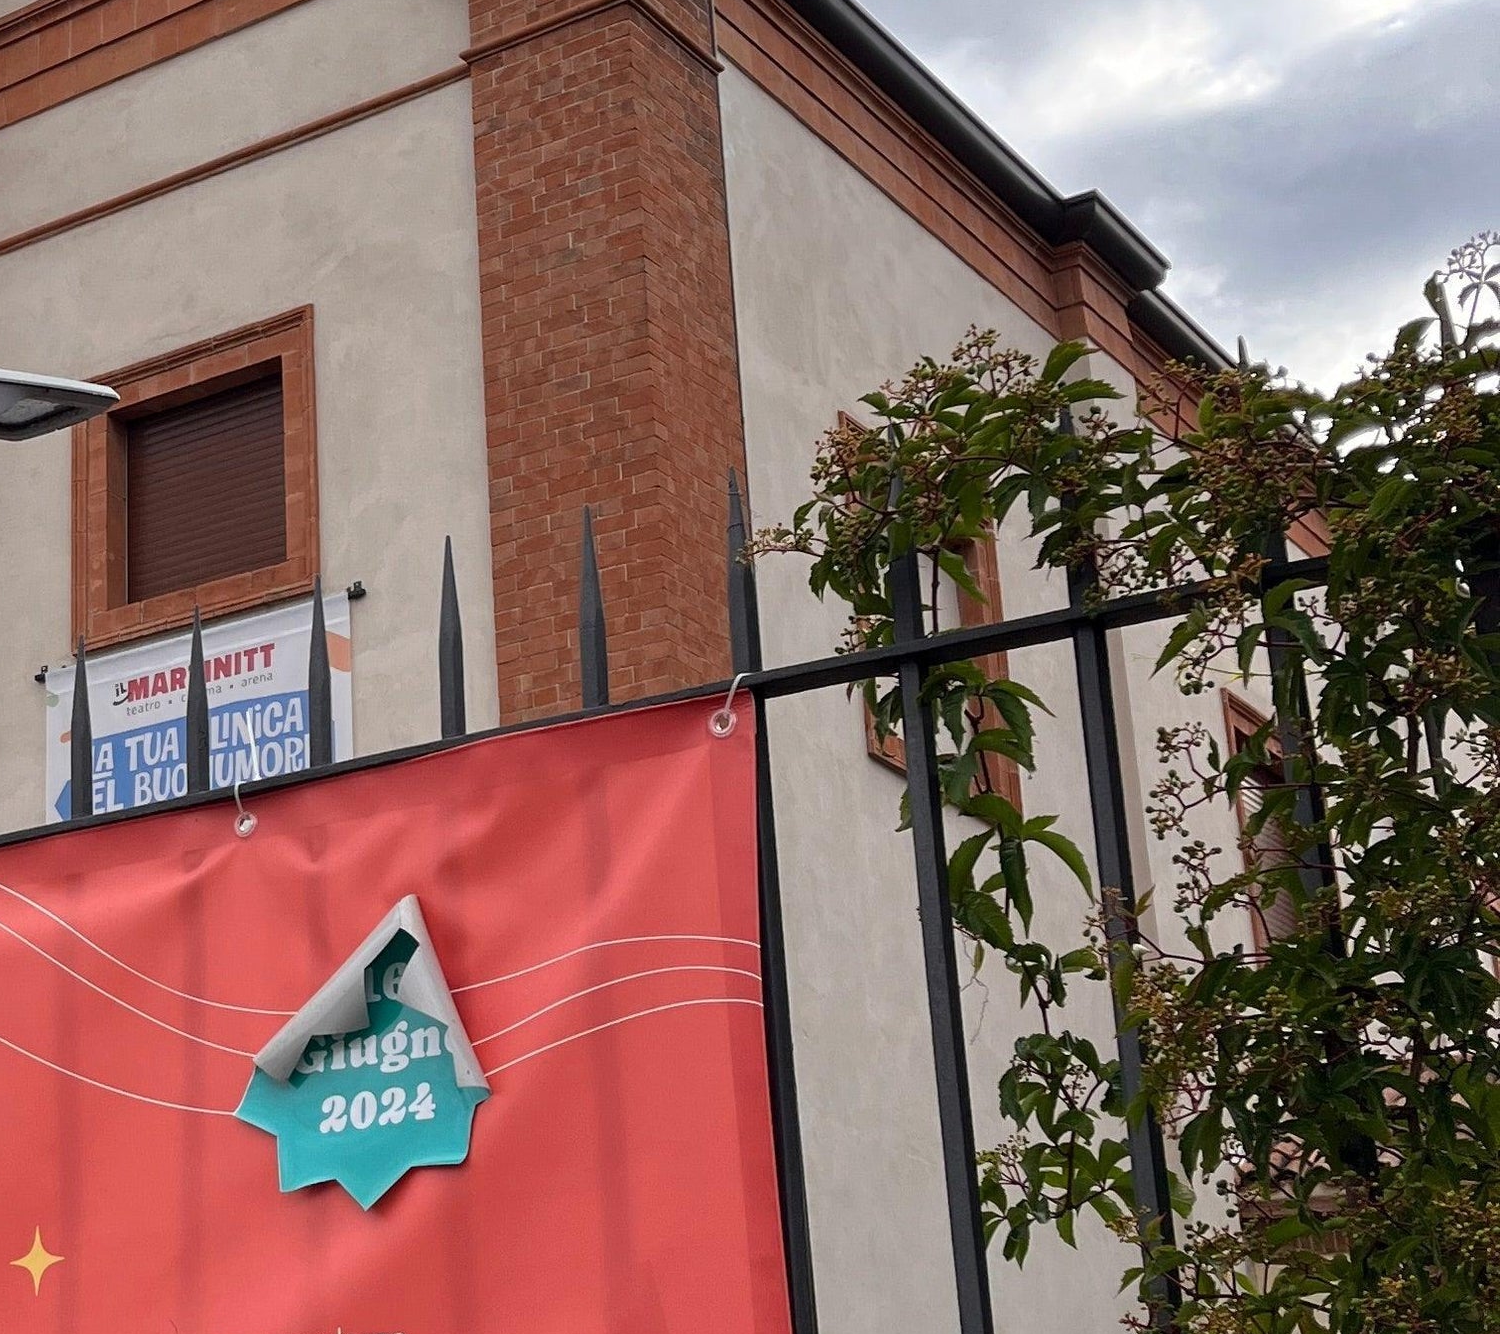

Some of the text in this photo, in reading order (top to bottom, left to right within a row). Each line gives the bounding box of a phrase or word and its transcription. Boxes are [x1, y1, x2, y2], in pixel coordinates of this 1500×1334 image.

[126, 699, 161, 716] teatro
[241, 672, 273, 688] arena
[128, 643, 276, 702] MARINITT
[92, 742, 114, 772] A
[125, 727, 179, 772] TUA
[319, 1082, 436, 1134] 2024
